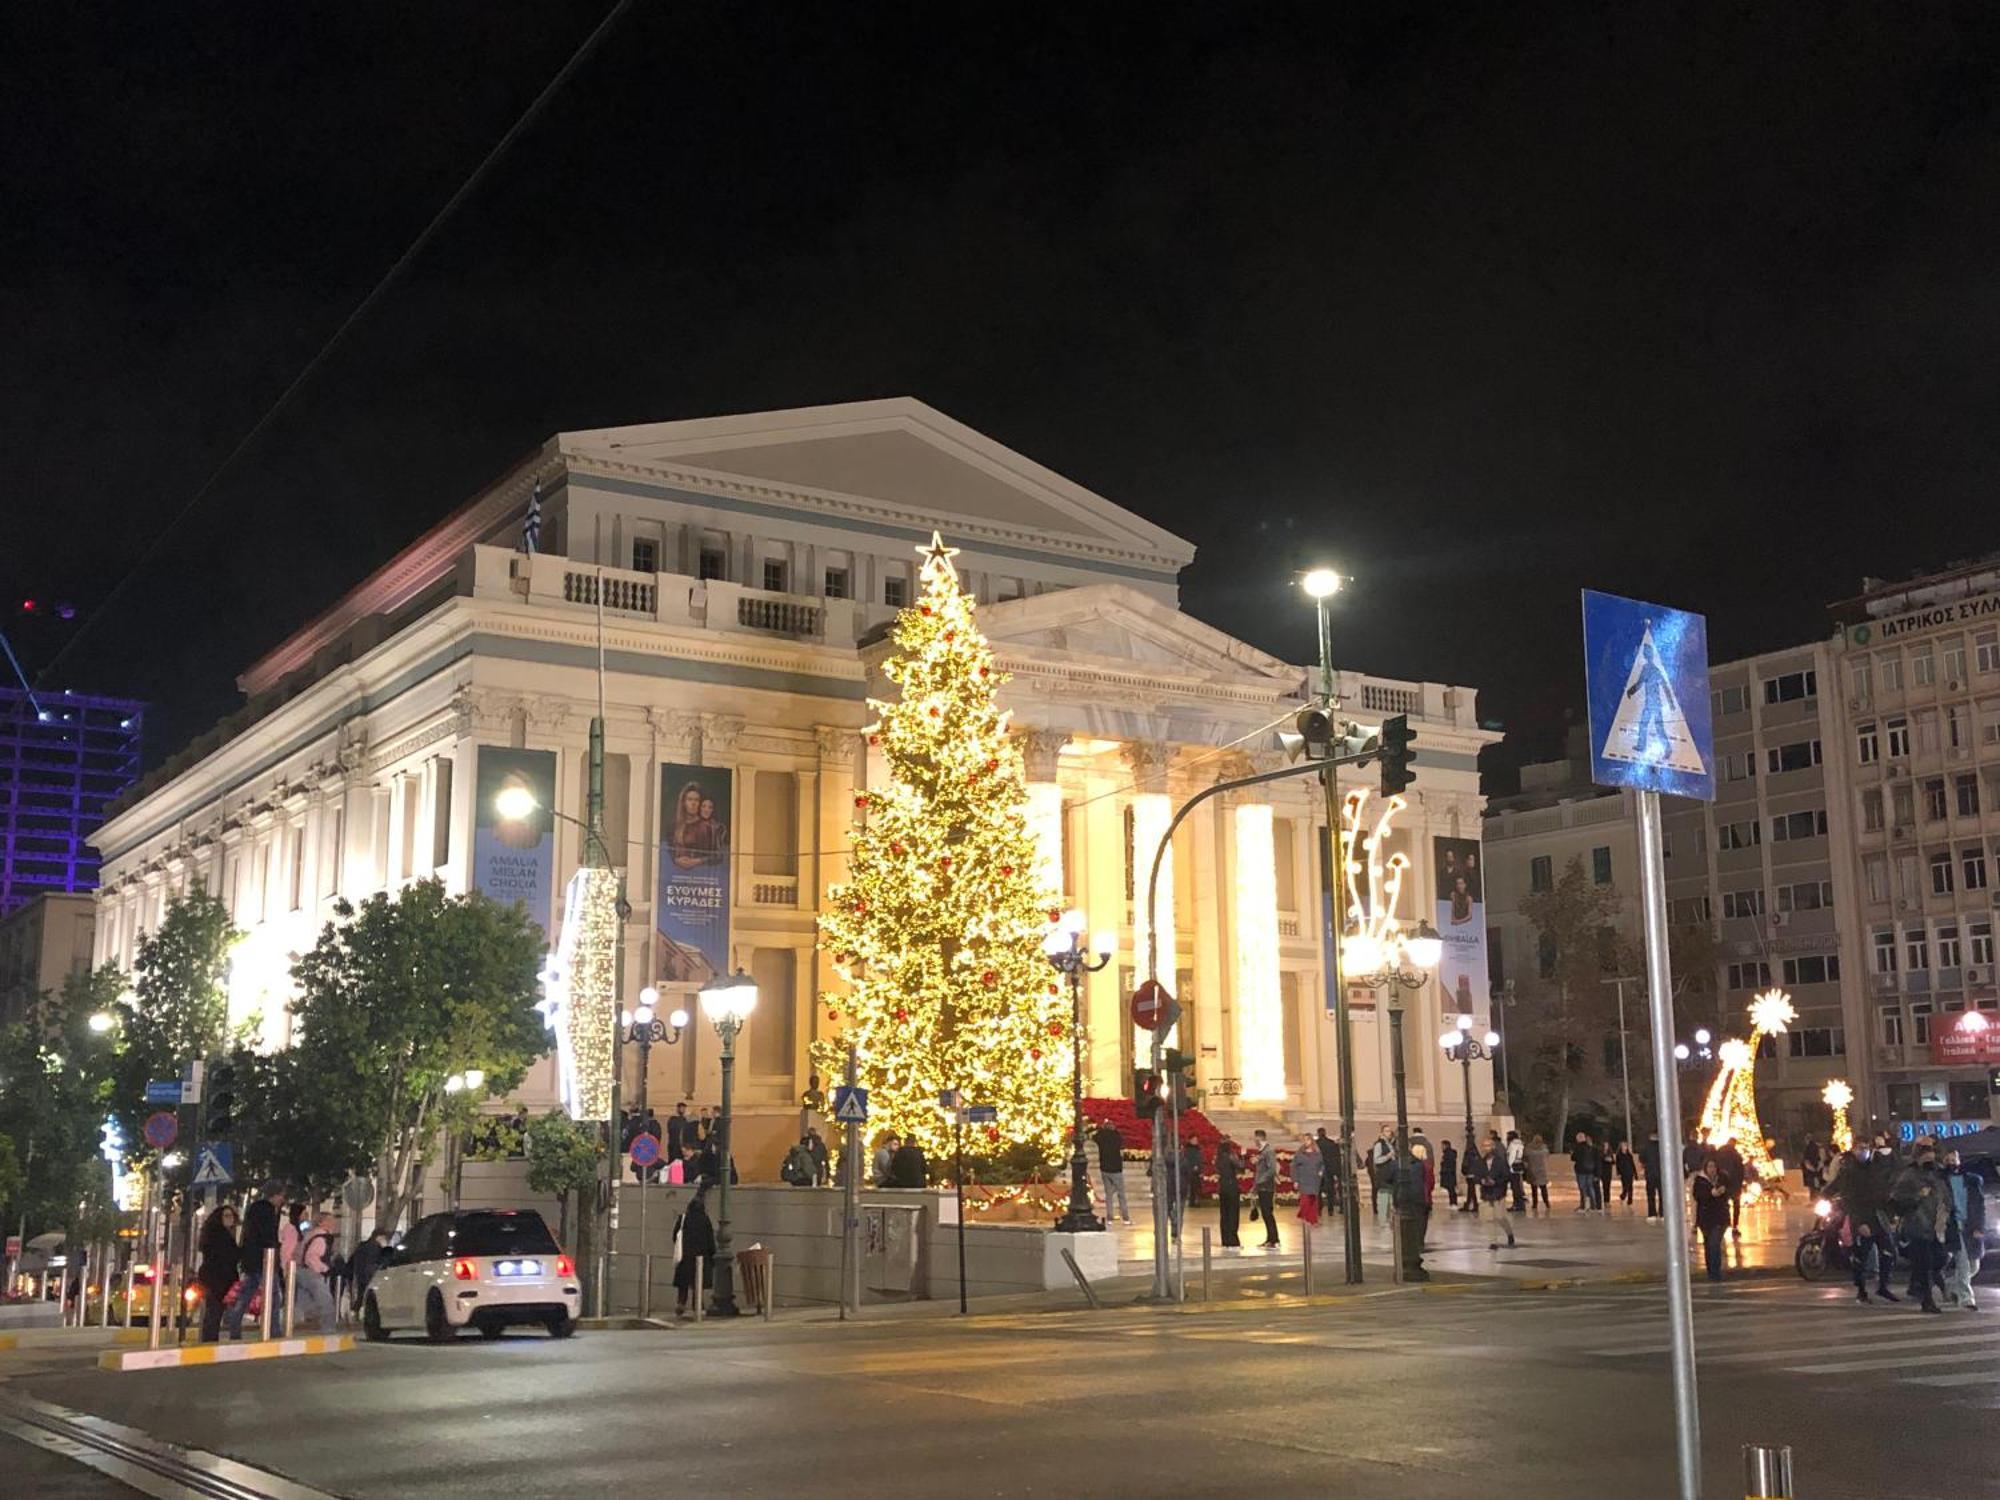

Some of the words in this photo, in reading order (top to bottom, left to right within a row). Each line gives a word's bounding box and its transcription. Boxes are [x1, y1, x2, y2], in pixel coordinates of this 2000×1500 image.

[1882, 607, 1954, 637] ΙΑΤΡΙΚΟΣ
[489, 855, 538, 867] AMALIA
[492, 866, 537, 878] MELAN
[489, 878, 537, 889] CHOLIA
[667, 896, 722, 908] ΚΥΡΑΔΕΣ
